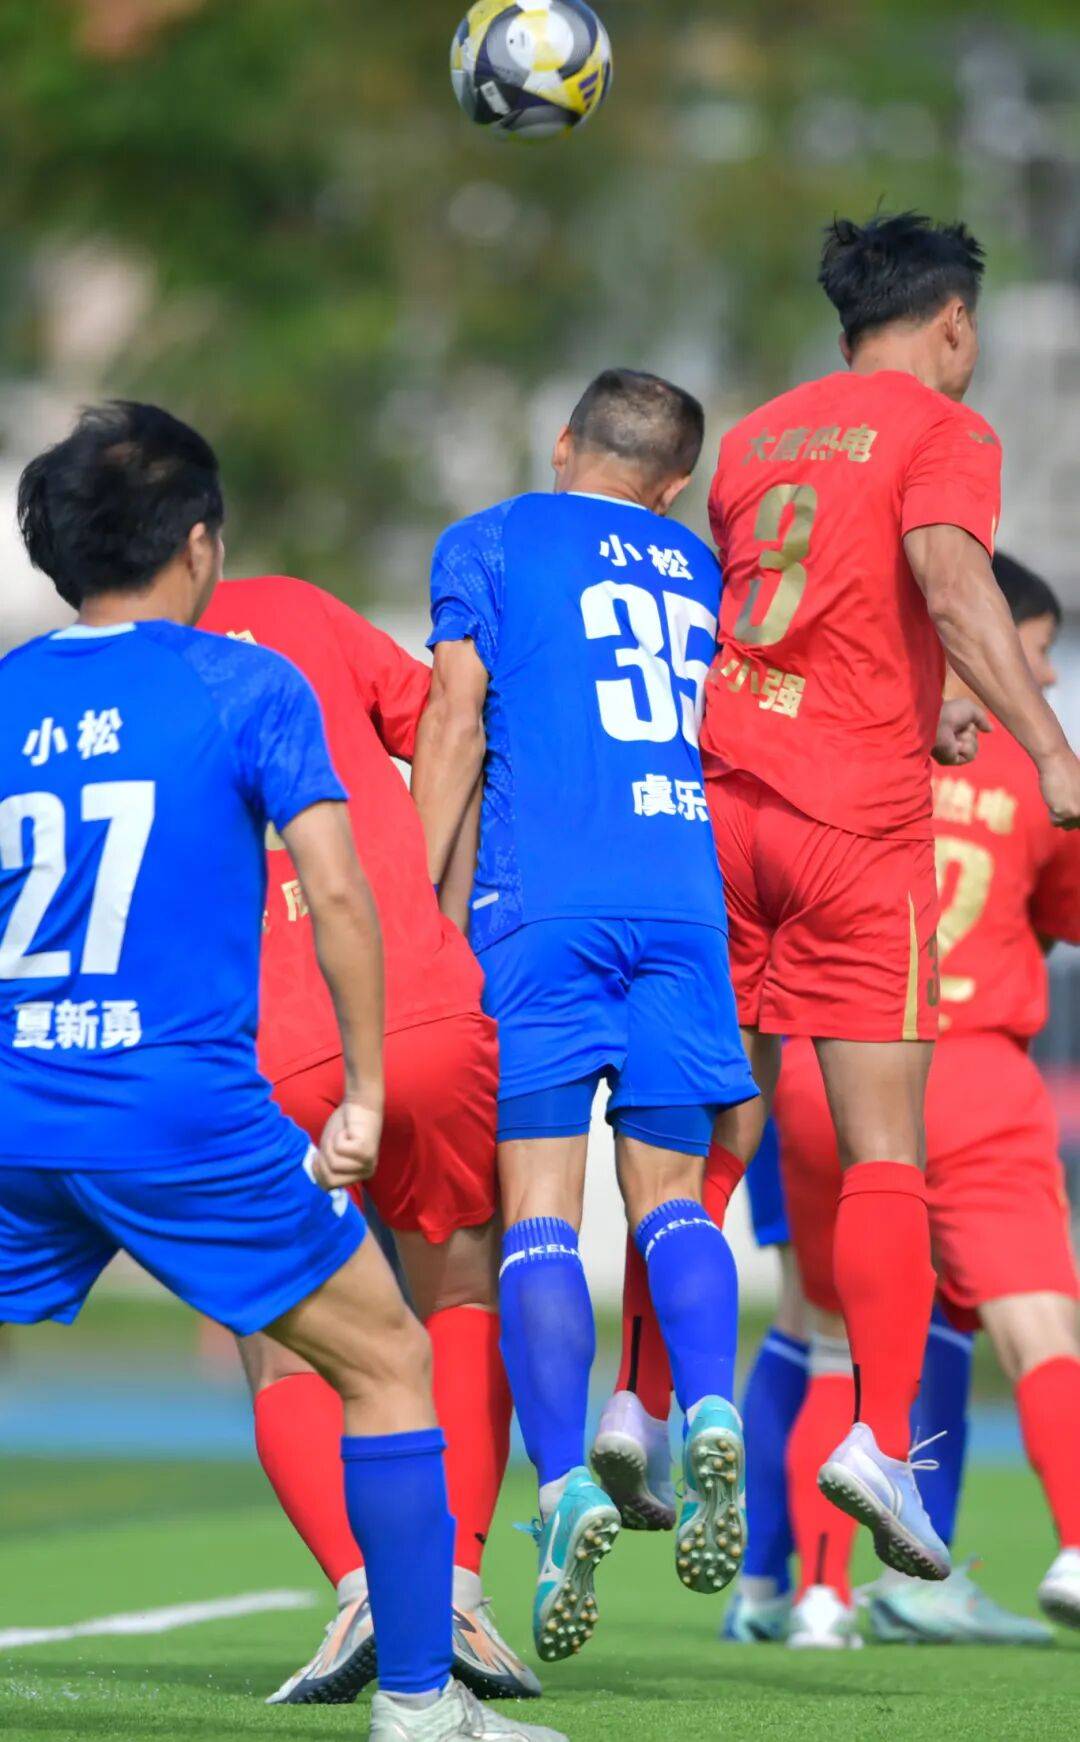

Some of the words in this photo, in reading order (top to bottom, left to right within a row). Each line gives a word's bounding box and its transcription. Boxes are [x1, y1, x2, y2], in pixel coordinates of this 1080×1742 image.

[743, 423, 878, 465] 大唐热电
[600, 534, 693, 580] 小松
[733, 484, 818, 646] 3
[580, 580, 717, 751] 35
[22, 707, 123, 766] 小松
[0, 780, 156, 980] 27
[12, 999, 142, 1050] 夏新勇
